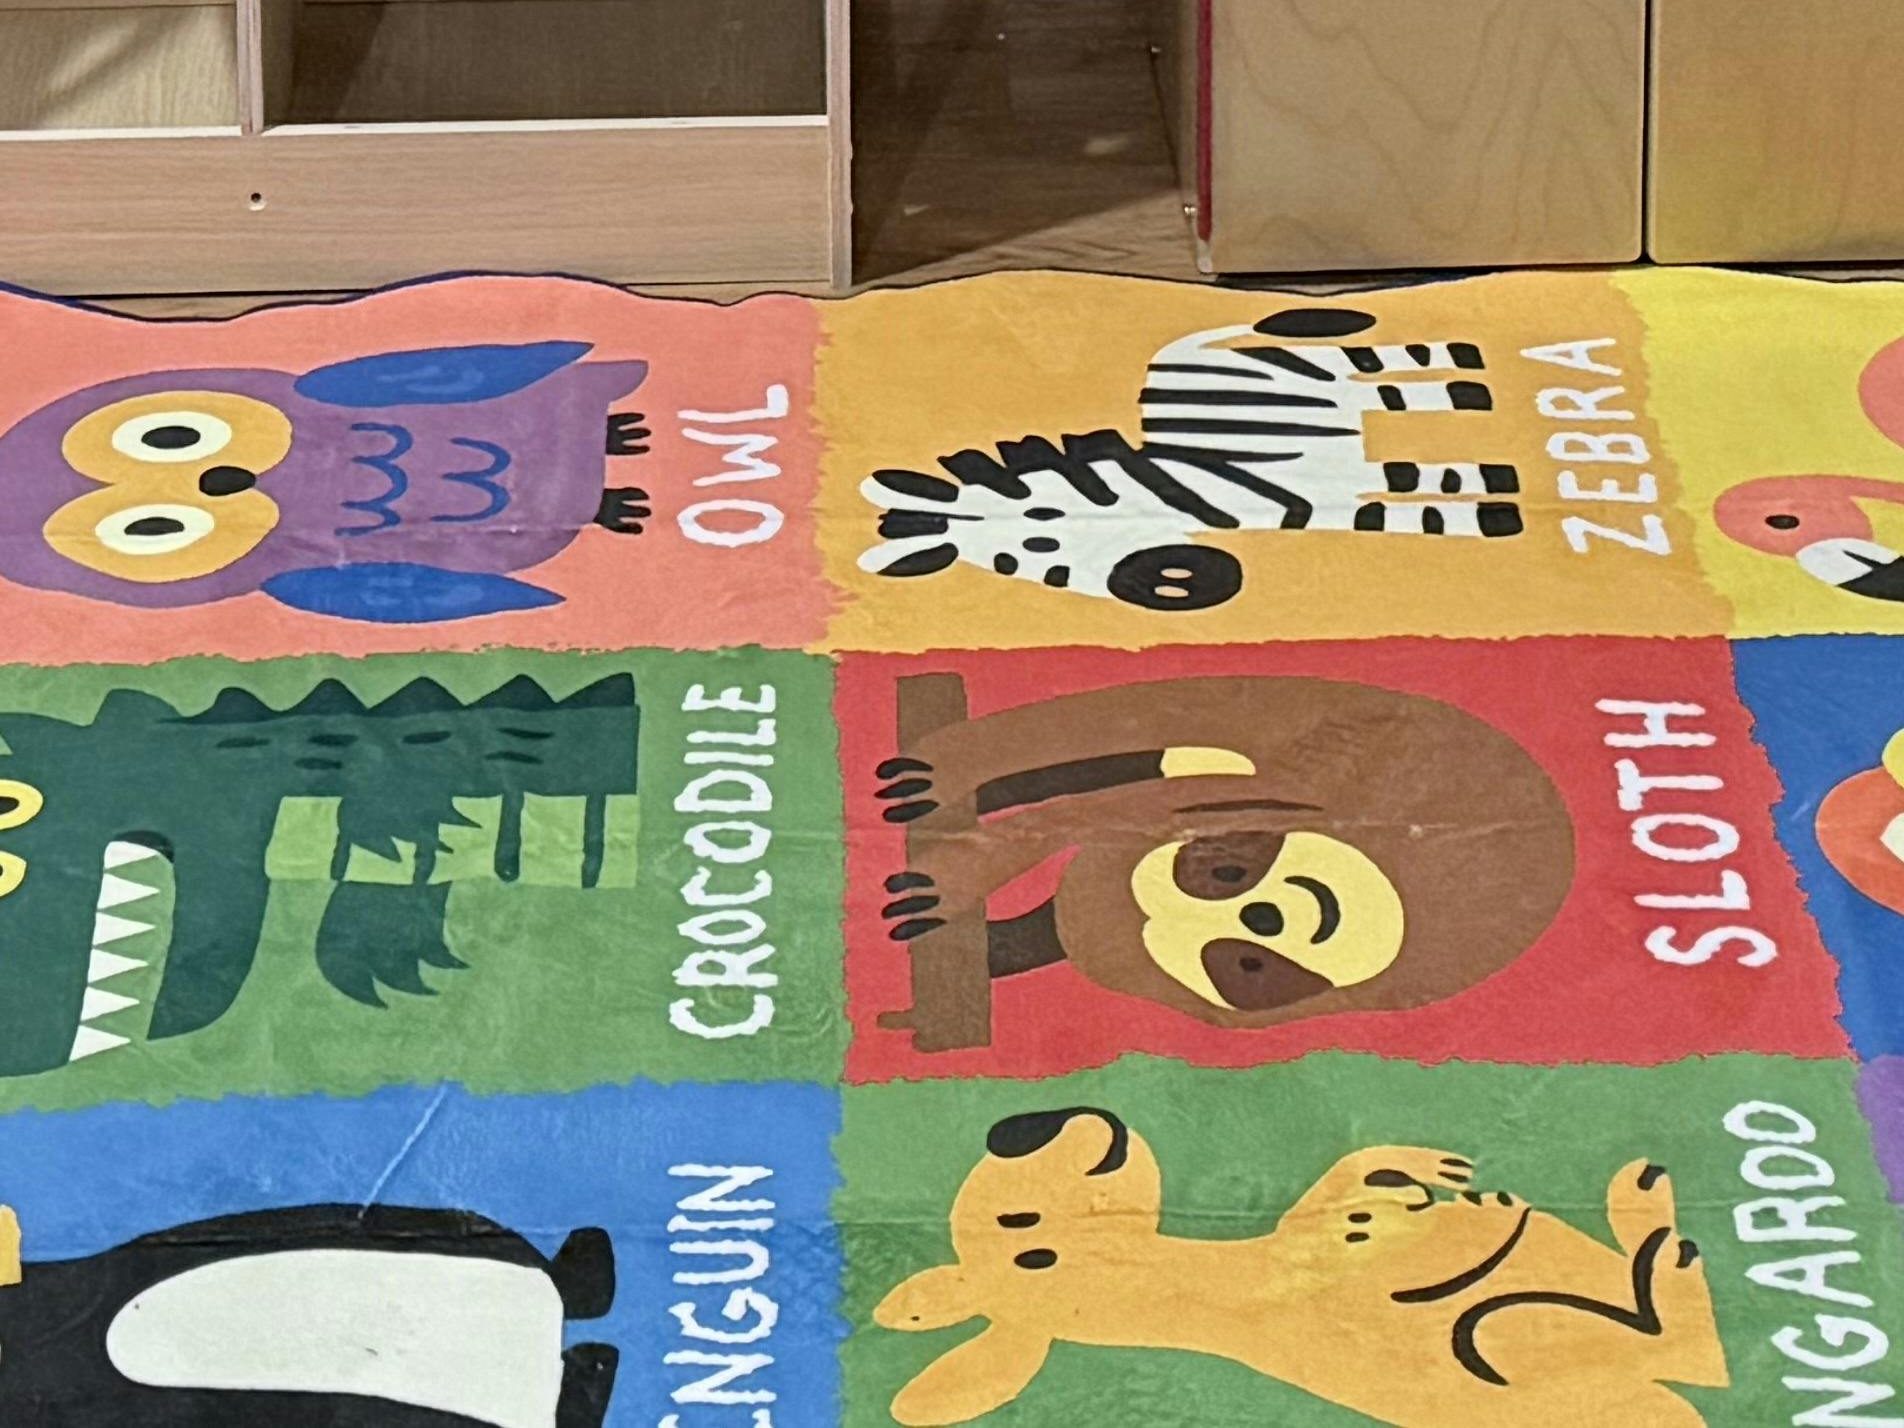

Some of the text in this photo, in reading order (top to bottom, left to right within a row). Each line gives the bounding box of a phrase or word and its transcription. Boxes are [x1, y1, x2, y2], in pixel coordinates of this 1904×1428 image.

[676, 383, 790, 548] OWL
[1529, 337, 1672, 556] ZEBRA
[668, 681, 779, 1040] CROCODILE
[1595, 699, 1778, 968] SLOTH
[658, 1163, 779, 1428] NGUIN
